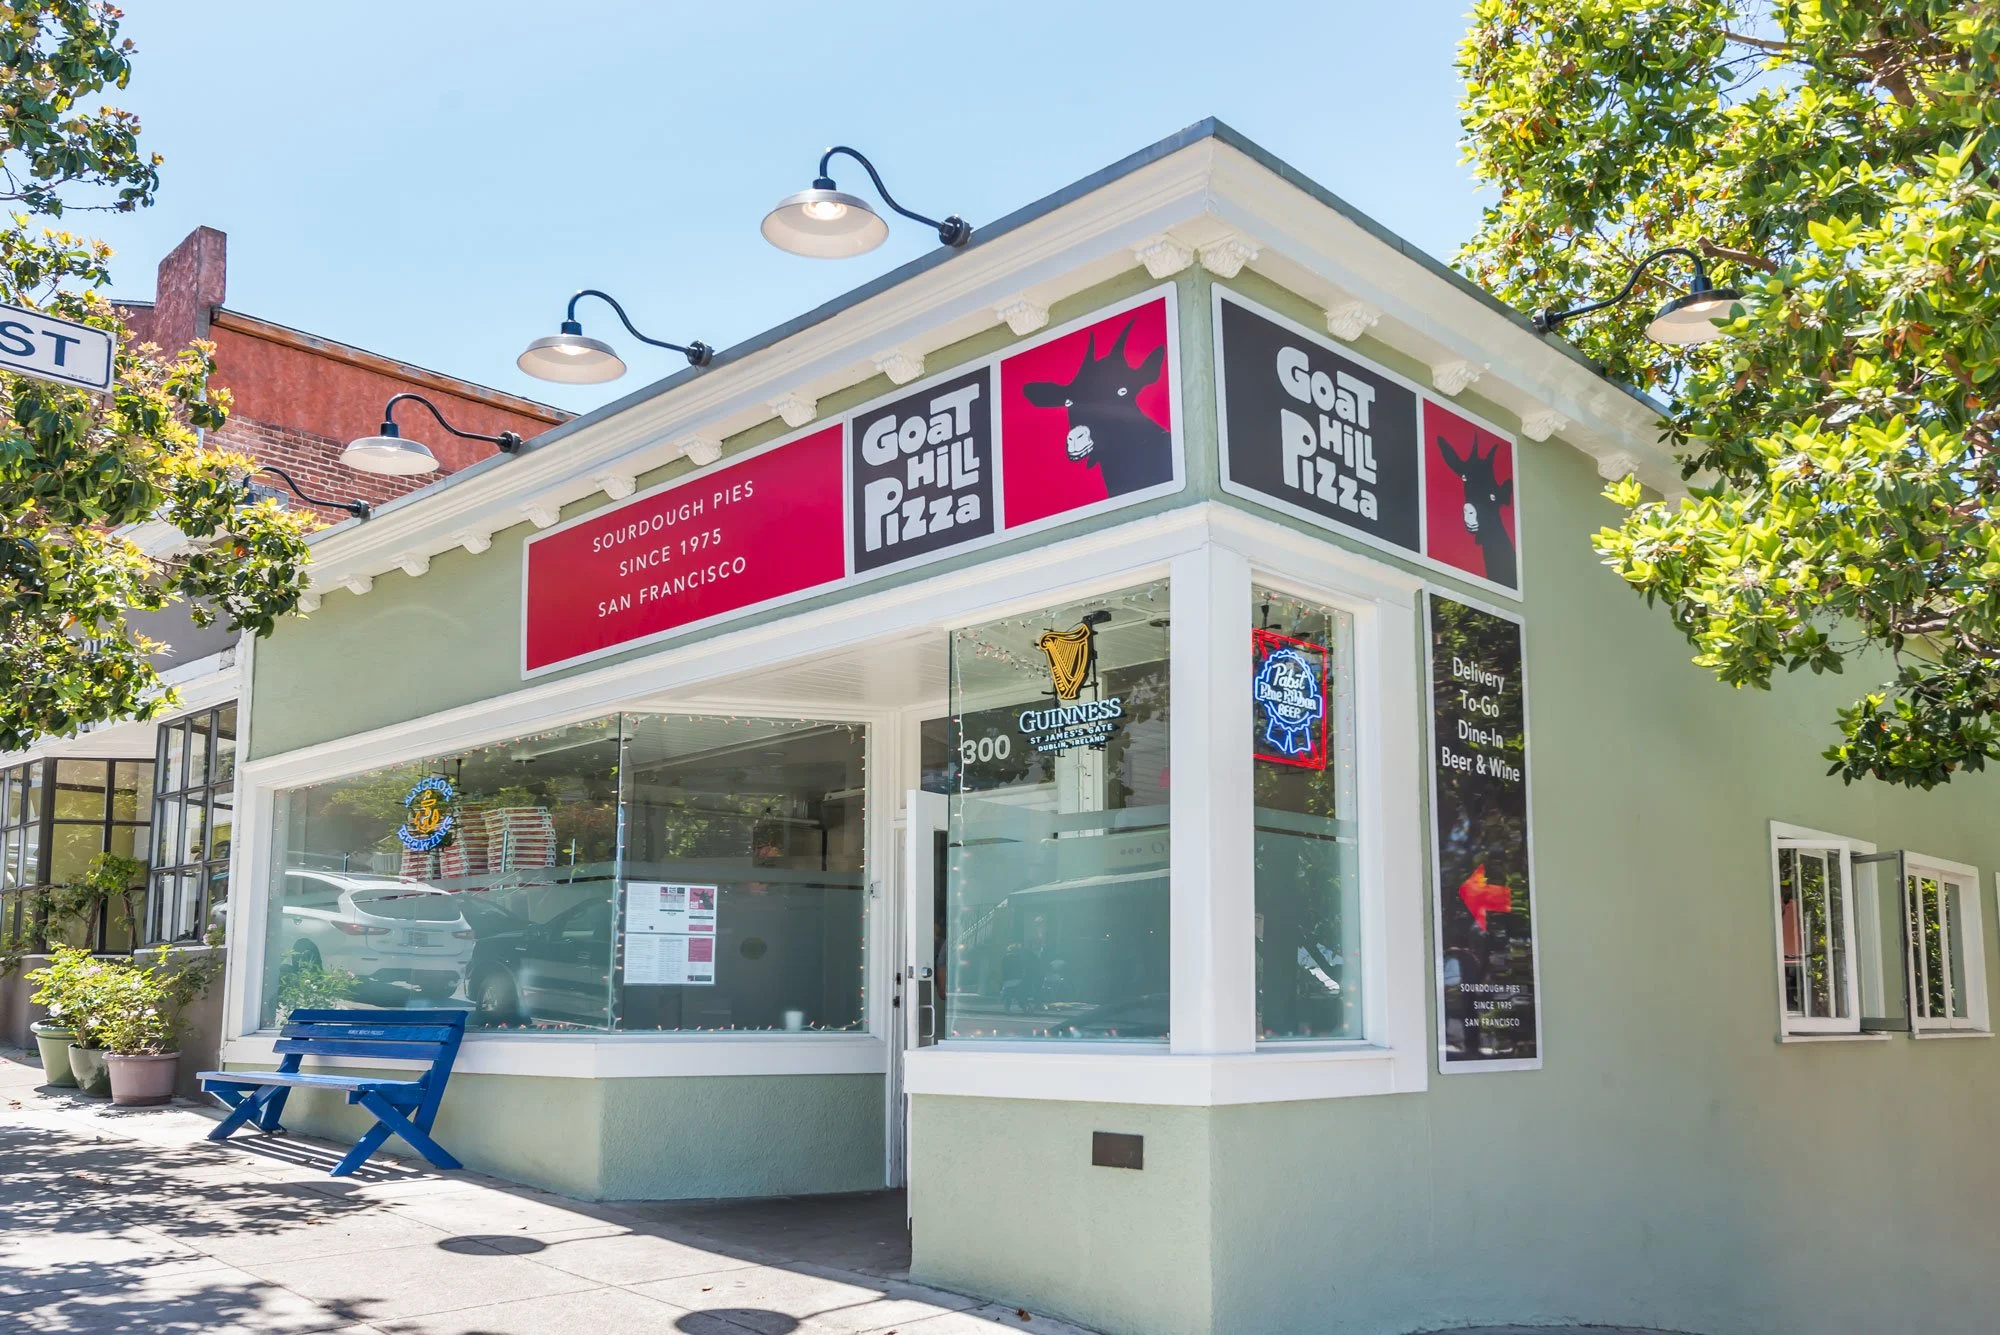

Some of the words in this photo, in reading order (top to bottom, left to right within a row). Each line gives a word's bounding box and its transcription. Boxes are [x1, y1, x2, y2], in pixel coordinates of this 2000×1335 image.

[0, 320, 81, 367] ST
[1280, 408, 1378, 521] Pizza
[592, 498, 704, 553] SOURDOUGH
[713, 480, 754, 509] PIES
[864, 477, 981, 552] Pizza
[619, 545, 671, 577] SINCE
[680, 528, 722, 556] 1975
[598, 594, 631, 618] SAN
[639, 556, 746, 604] FRANCISCO
[1272, 662, 1308, 690] Pabst
[1452, 656, 1505, 695] Delivery
[1260, 681, 1283, 702] Blue
[1282, 687, 1317, 710] Ribbon
[1460, 689, 1500, 718] To-Go
[1019, 697, 1122, 733] GUINNESS
[962, 734, 1011, 765] 300
[1030, 736, 1041, 745] ST
[1045, 728, 1084, 742] JAMES'S
[1088, 723, 1113, 734] GATE
[1038, 742, 1069, 752] DUBLIN,
[1071, 735, 1106, 746] IRELAND
[1458, 719, 1504, 749] Dine-In
[1442, 746, 1473, 772] Beer
[1476, 754, 1487, 775] &
[1489, 757, 1521, 782] Wine
[1460, 984, 1504, 993] SOURDOUGH
[1506, 985, 1520, 993] PIES
[1473, 1001, 1495, 1010] SINCE
[1496, 1001, 1512, 1010] 1975
[1464, 1018, 1479, 1027] SAN
[1481, 1018, 1520, 1027] FRANCISCO
